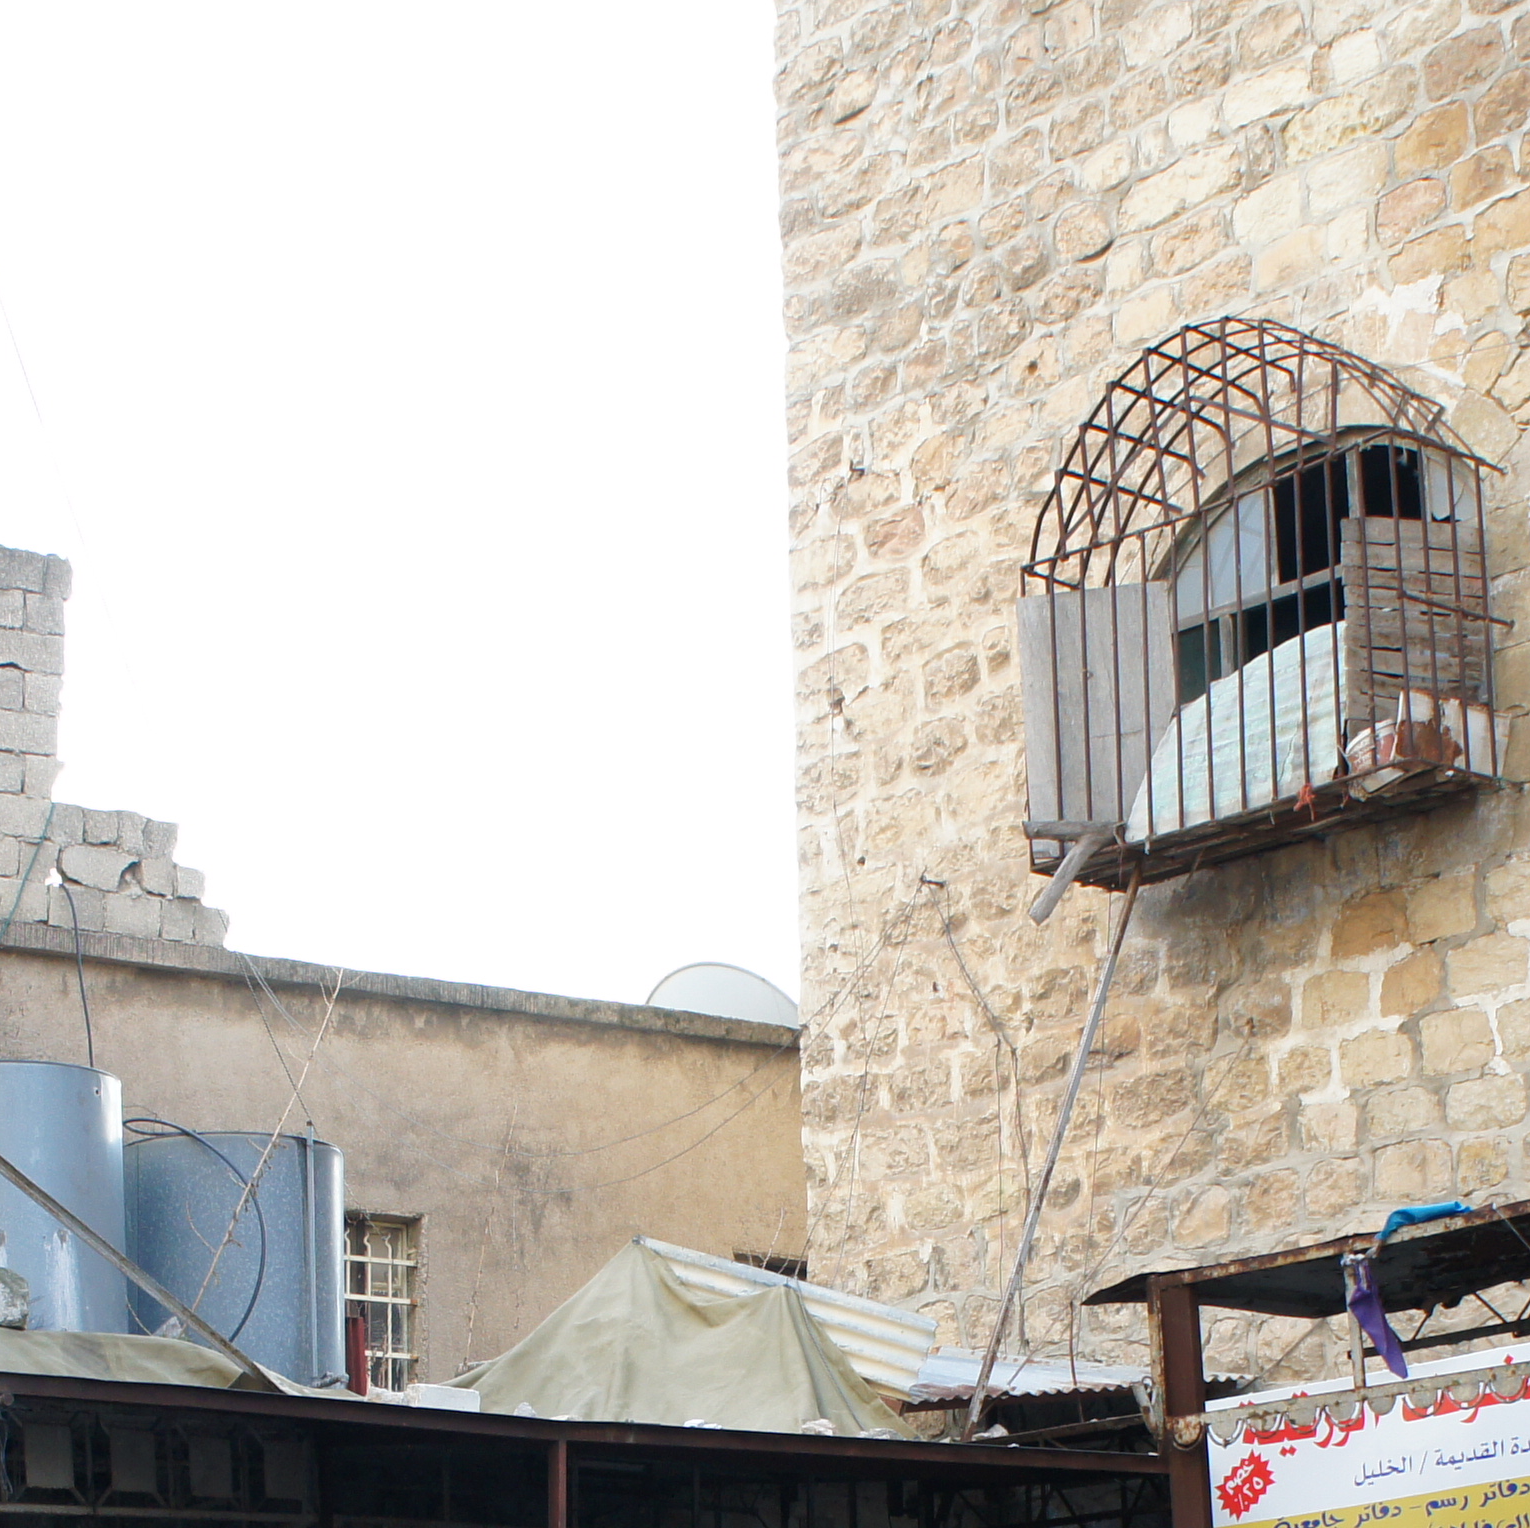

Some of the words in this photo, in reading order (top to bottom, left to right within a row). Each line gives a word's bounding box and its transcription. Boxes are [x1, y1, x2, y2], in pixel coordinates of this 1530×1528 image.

[1434, 1439, 1505, 1471] القديمة
[1354, 1456, 1413, 1487] الخليل
[1425, 1495, 1469, 1517] رسم
[1479, 1480, 1530, 1508] دفاتر
[1354, 1502, 1402, 1528] دفاتر
